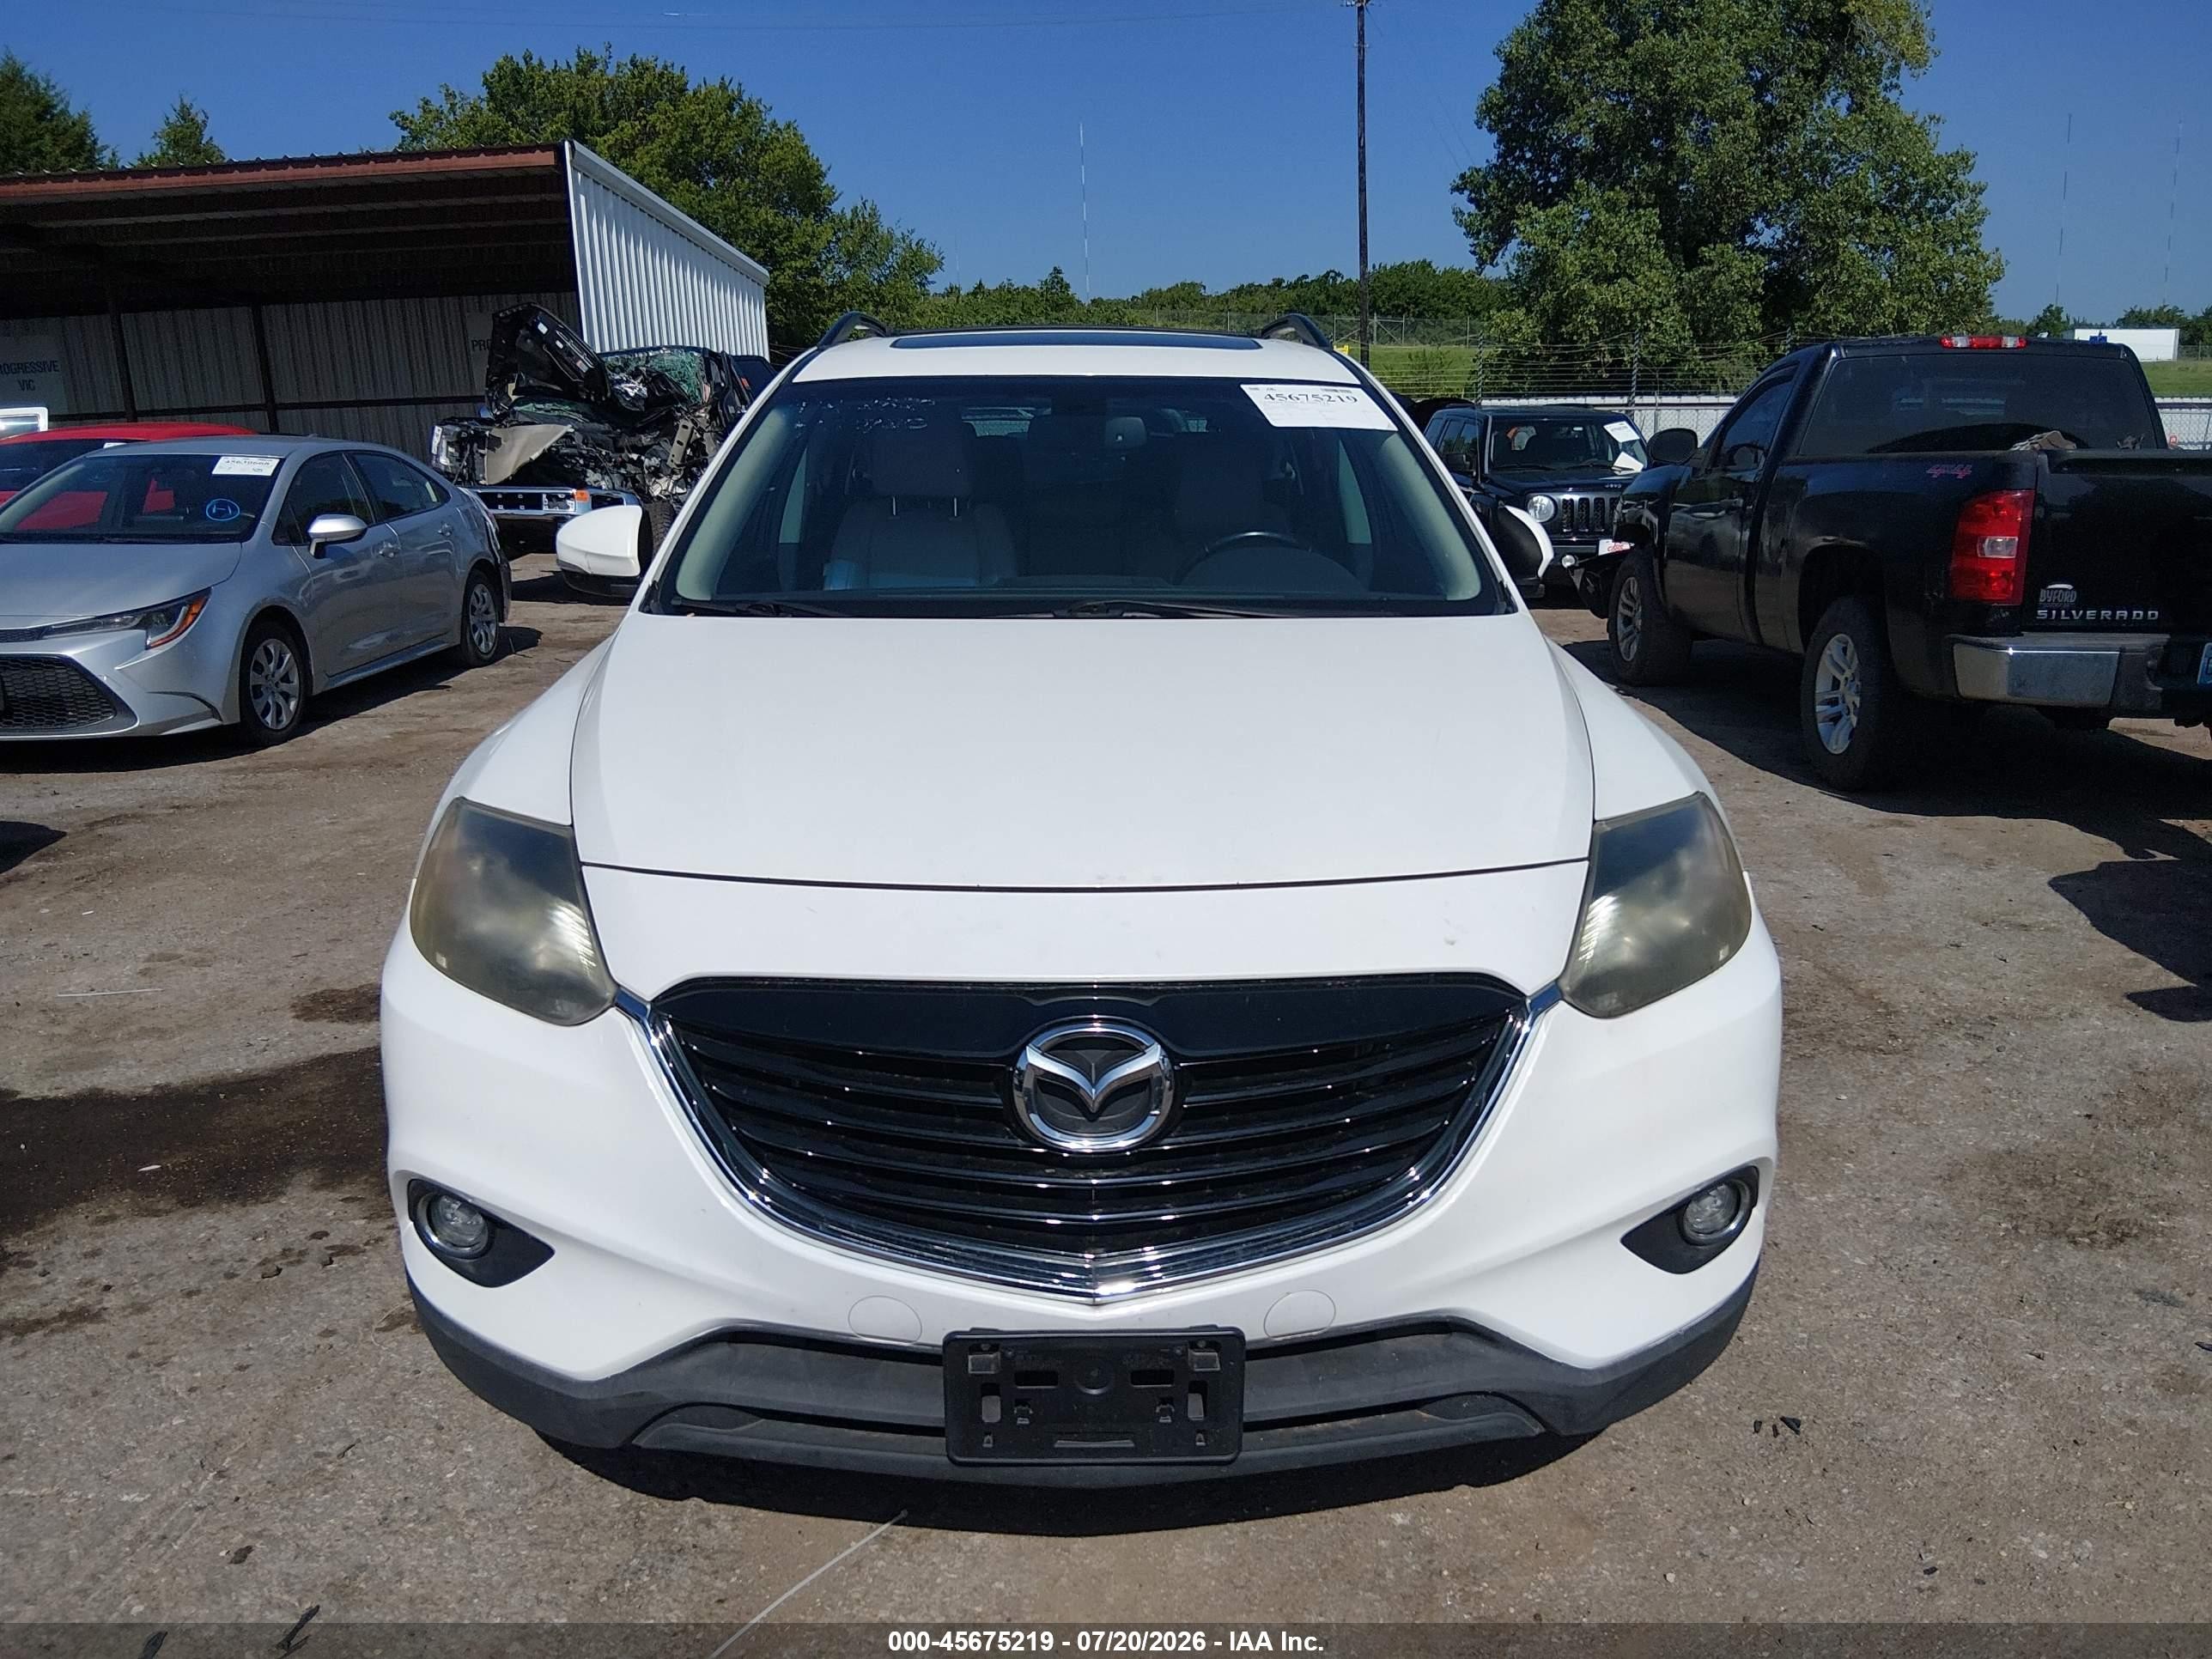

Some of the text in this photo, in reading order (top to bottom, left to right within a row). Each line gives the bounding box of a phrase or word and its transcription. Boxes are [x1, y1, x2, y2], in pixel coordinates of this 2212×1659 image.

[17, 380, 35, 391] VIC
[1264, 392, 1358, 404] 45675219
[2036, 610, 2159, 620] SILVERADO
